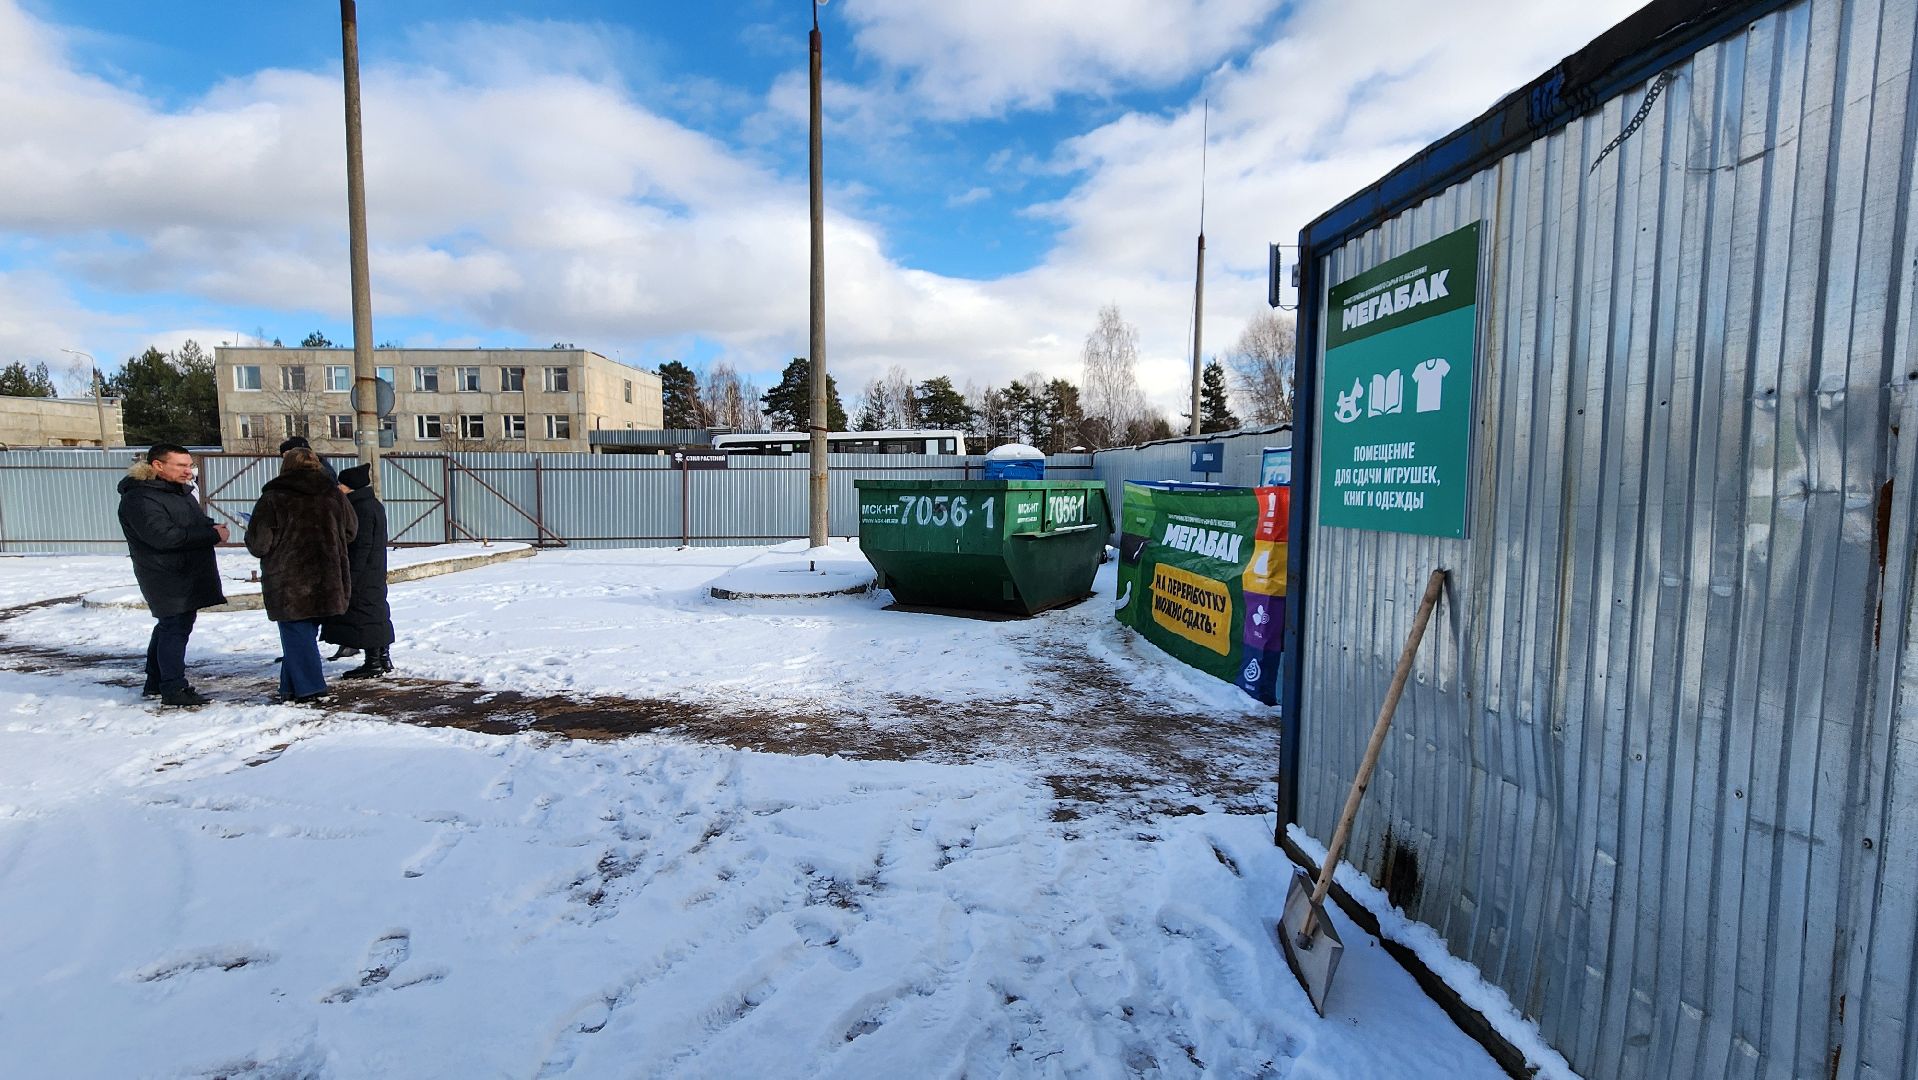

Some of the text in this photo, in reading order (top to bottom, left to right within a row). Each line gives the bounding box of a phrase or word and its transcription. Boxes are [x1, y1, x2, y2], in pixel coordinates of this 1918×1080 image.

[1342, 268, 1450, 332] МЕГАБАК
[1353, 441, 1416, 462] ПОМЕЩЕНИЕ
[1334, 465, 1441, 487] ДЛЯ СДАЧИ ИГРУШЕК,
[861, 504, 899, 515] МСК-НТ
[1344, 490, 1424, 511] КНИГ И ОДЕЖДЫ
[1161, 523, 1244, 564] МЕГАБАК
[1155, 574, 1227, 613] НА ПЕРЕРАБОТКУ
[1154, 594, 1217, 636] МОЖНО СДАТЬ:
